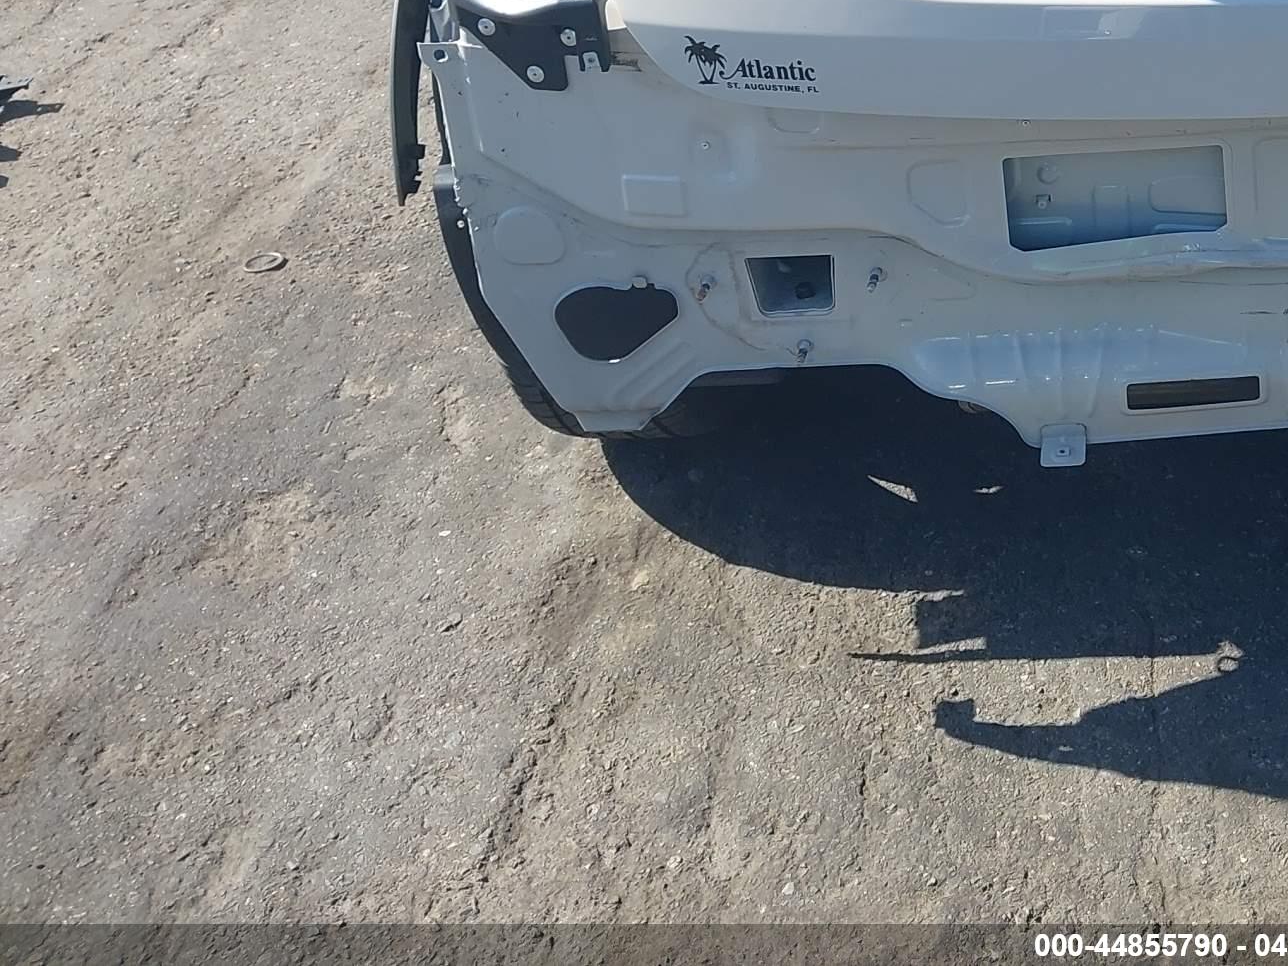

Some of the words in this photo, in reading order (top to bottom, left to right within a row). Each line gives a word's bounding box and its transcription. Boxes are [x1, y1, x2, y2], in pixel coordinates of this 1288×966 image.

[719, 57, 817, 82] Atlantic
[727, 81, 741, 90] ST.
[744, 83, 805, 93] AUGUSTINE,
[807, 85, 819, 93] FL
